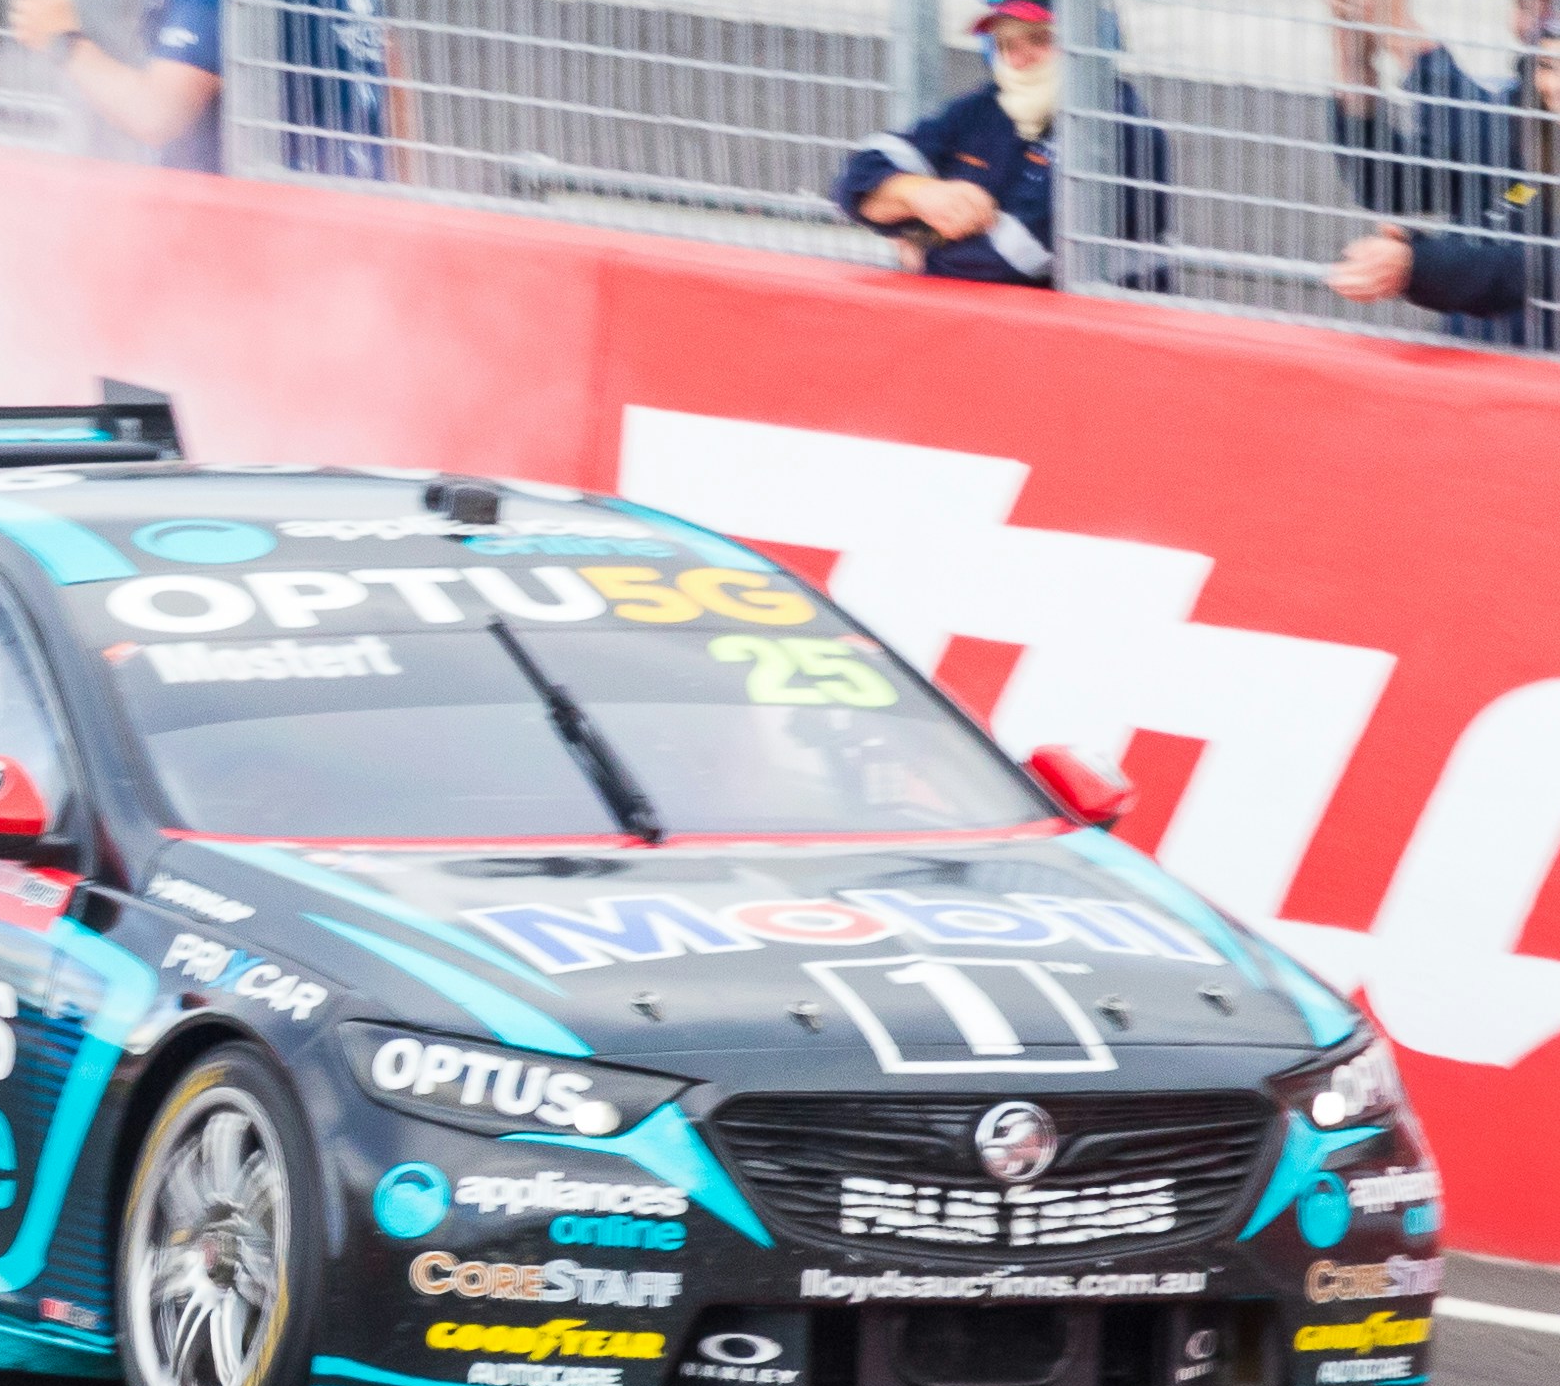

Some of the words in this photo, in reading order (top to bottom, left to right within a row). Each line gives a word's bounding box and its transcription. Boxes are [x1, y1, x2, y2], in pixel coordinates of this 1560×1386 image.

[707, 633, 900, 709] 25
[460, 887, 1225, 975] Mobil
[371, 1037, 594, 1127] OPTUS
[454, 1170, 690, 1216] appliances
[548, 1214, 688, 1251] online
[425, 1318, 666, 1361] GOODYEAR
